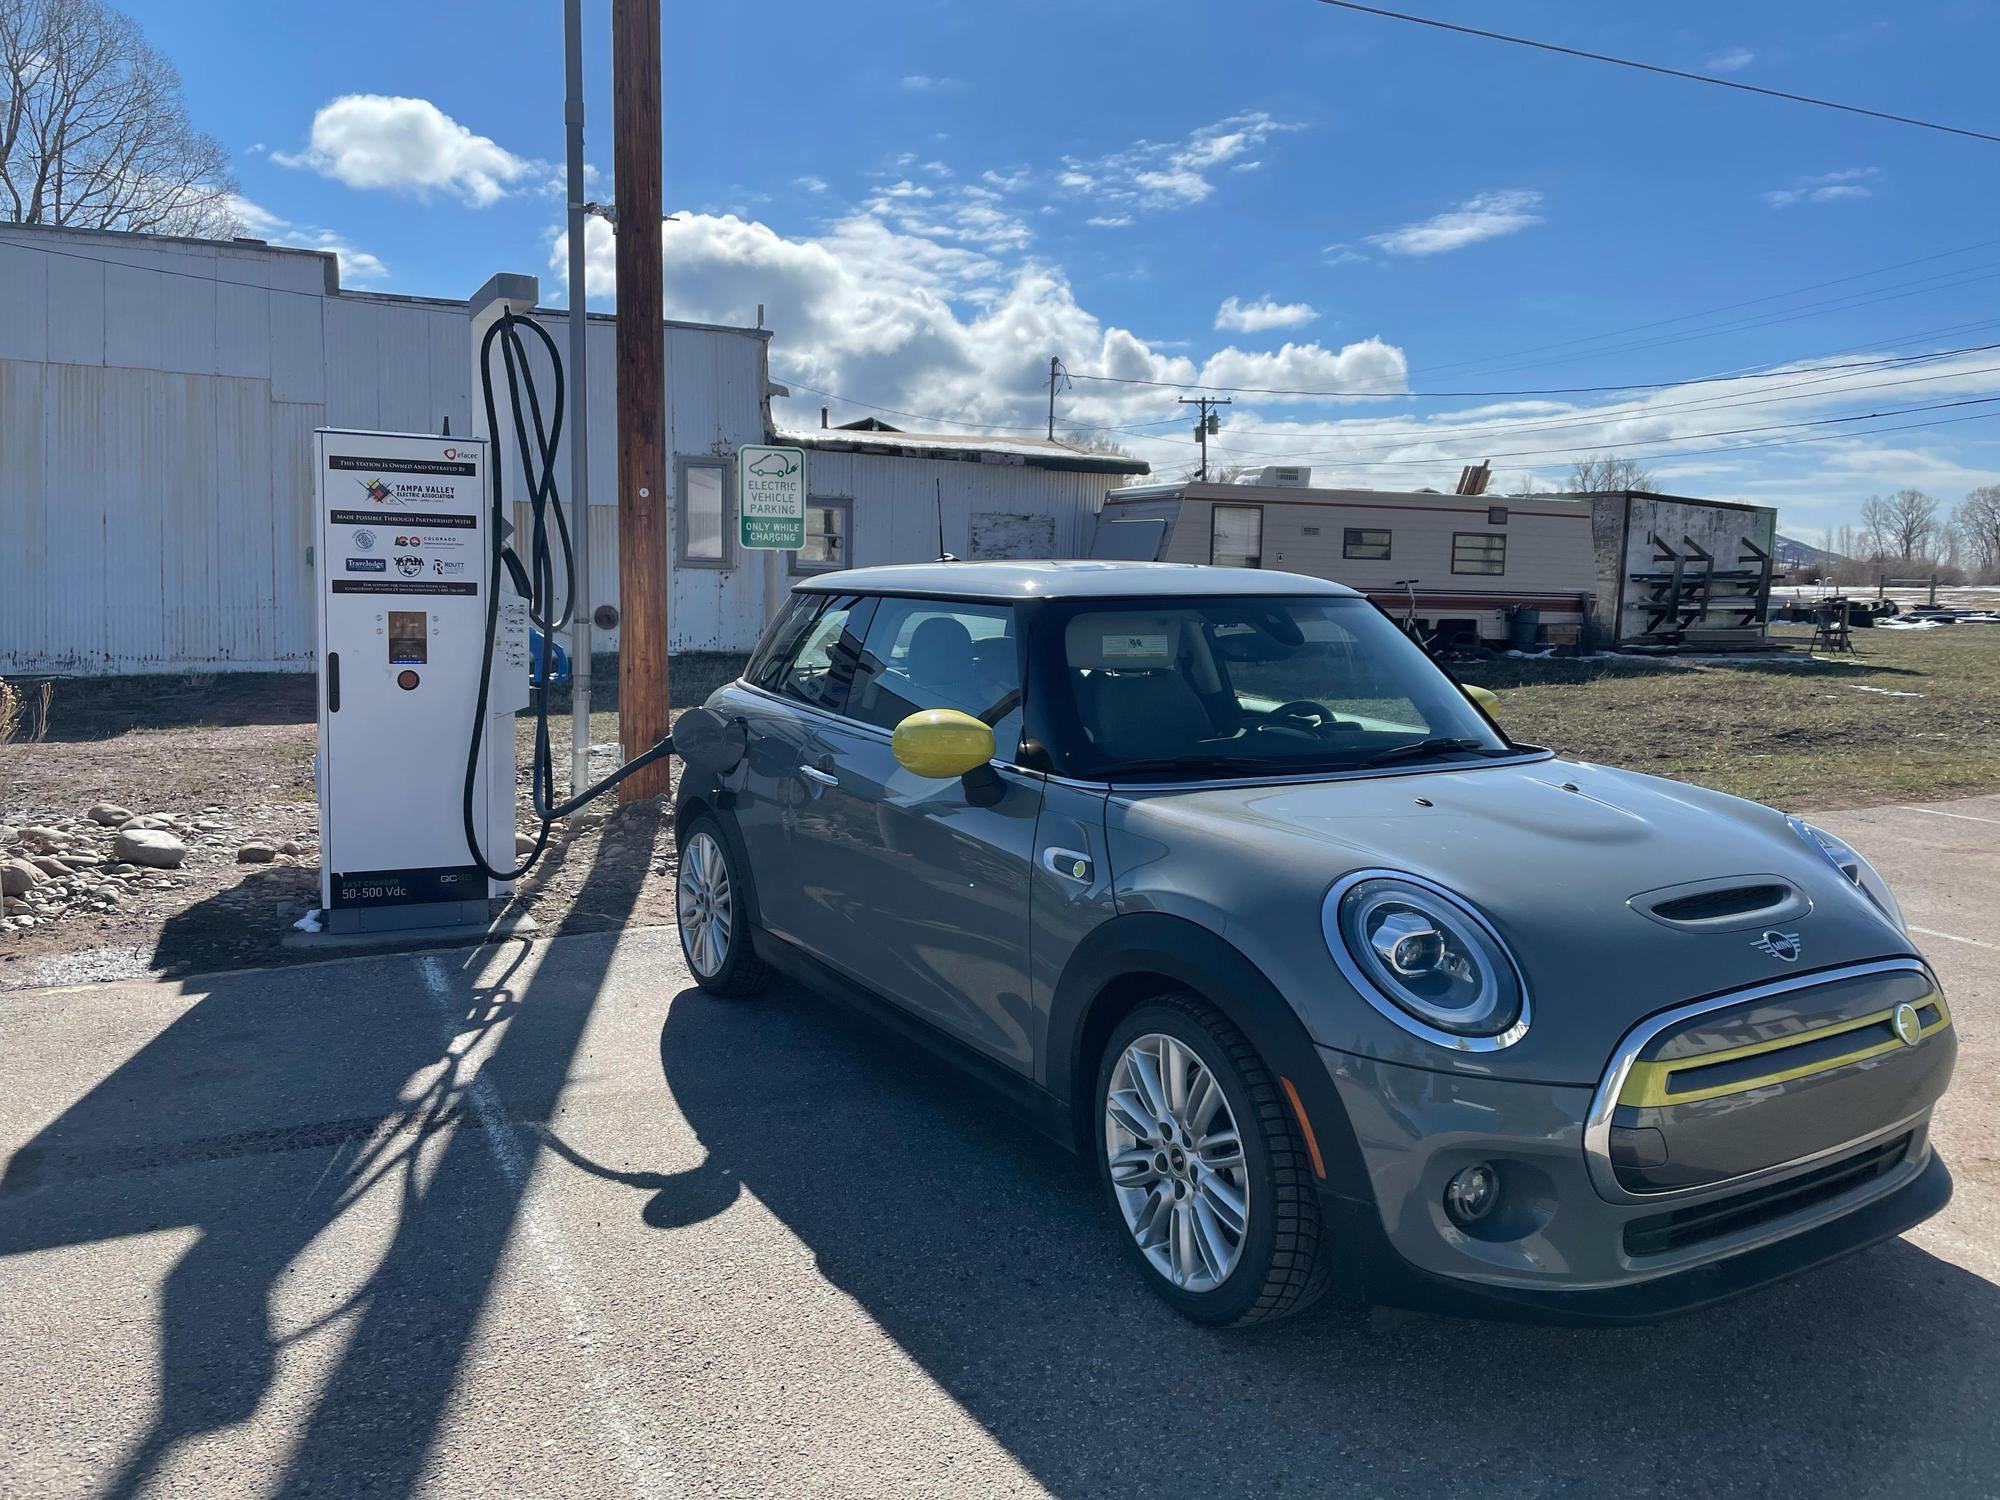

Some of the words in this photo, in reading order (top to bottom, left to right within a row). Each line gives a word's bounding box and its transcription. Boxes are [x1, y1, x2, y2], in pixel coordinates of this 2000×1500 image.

[457, 452, 478, 460] efacec
[396, 484, 423, 493] YAMPA
[425, 486, 455, 494] VALLEY
[748, 480, 796, 491] ELECTRIC
[752, 492, 794, 503] VEHICLE
[750, 504, 796, 515] PARKING
[746, 522, 770, 530] ONLY
[773, 523, 799, 532] WHILE
[750, 532, 796, 542] CHARGING
[348, 559, 384, 568] Travelodge
[342, 886, 382, 899] 50-500
[385, 886, 406, 897] Vdc
[1772, 940, 1792, 950] MINI
